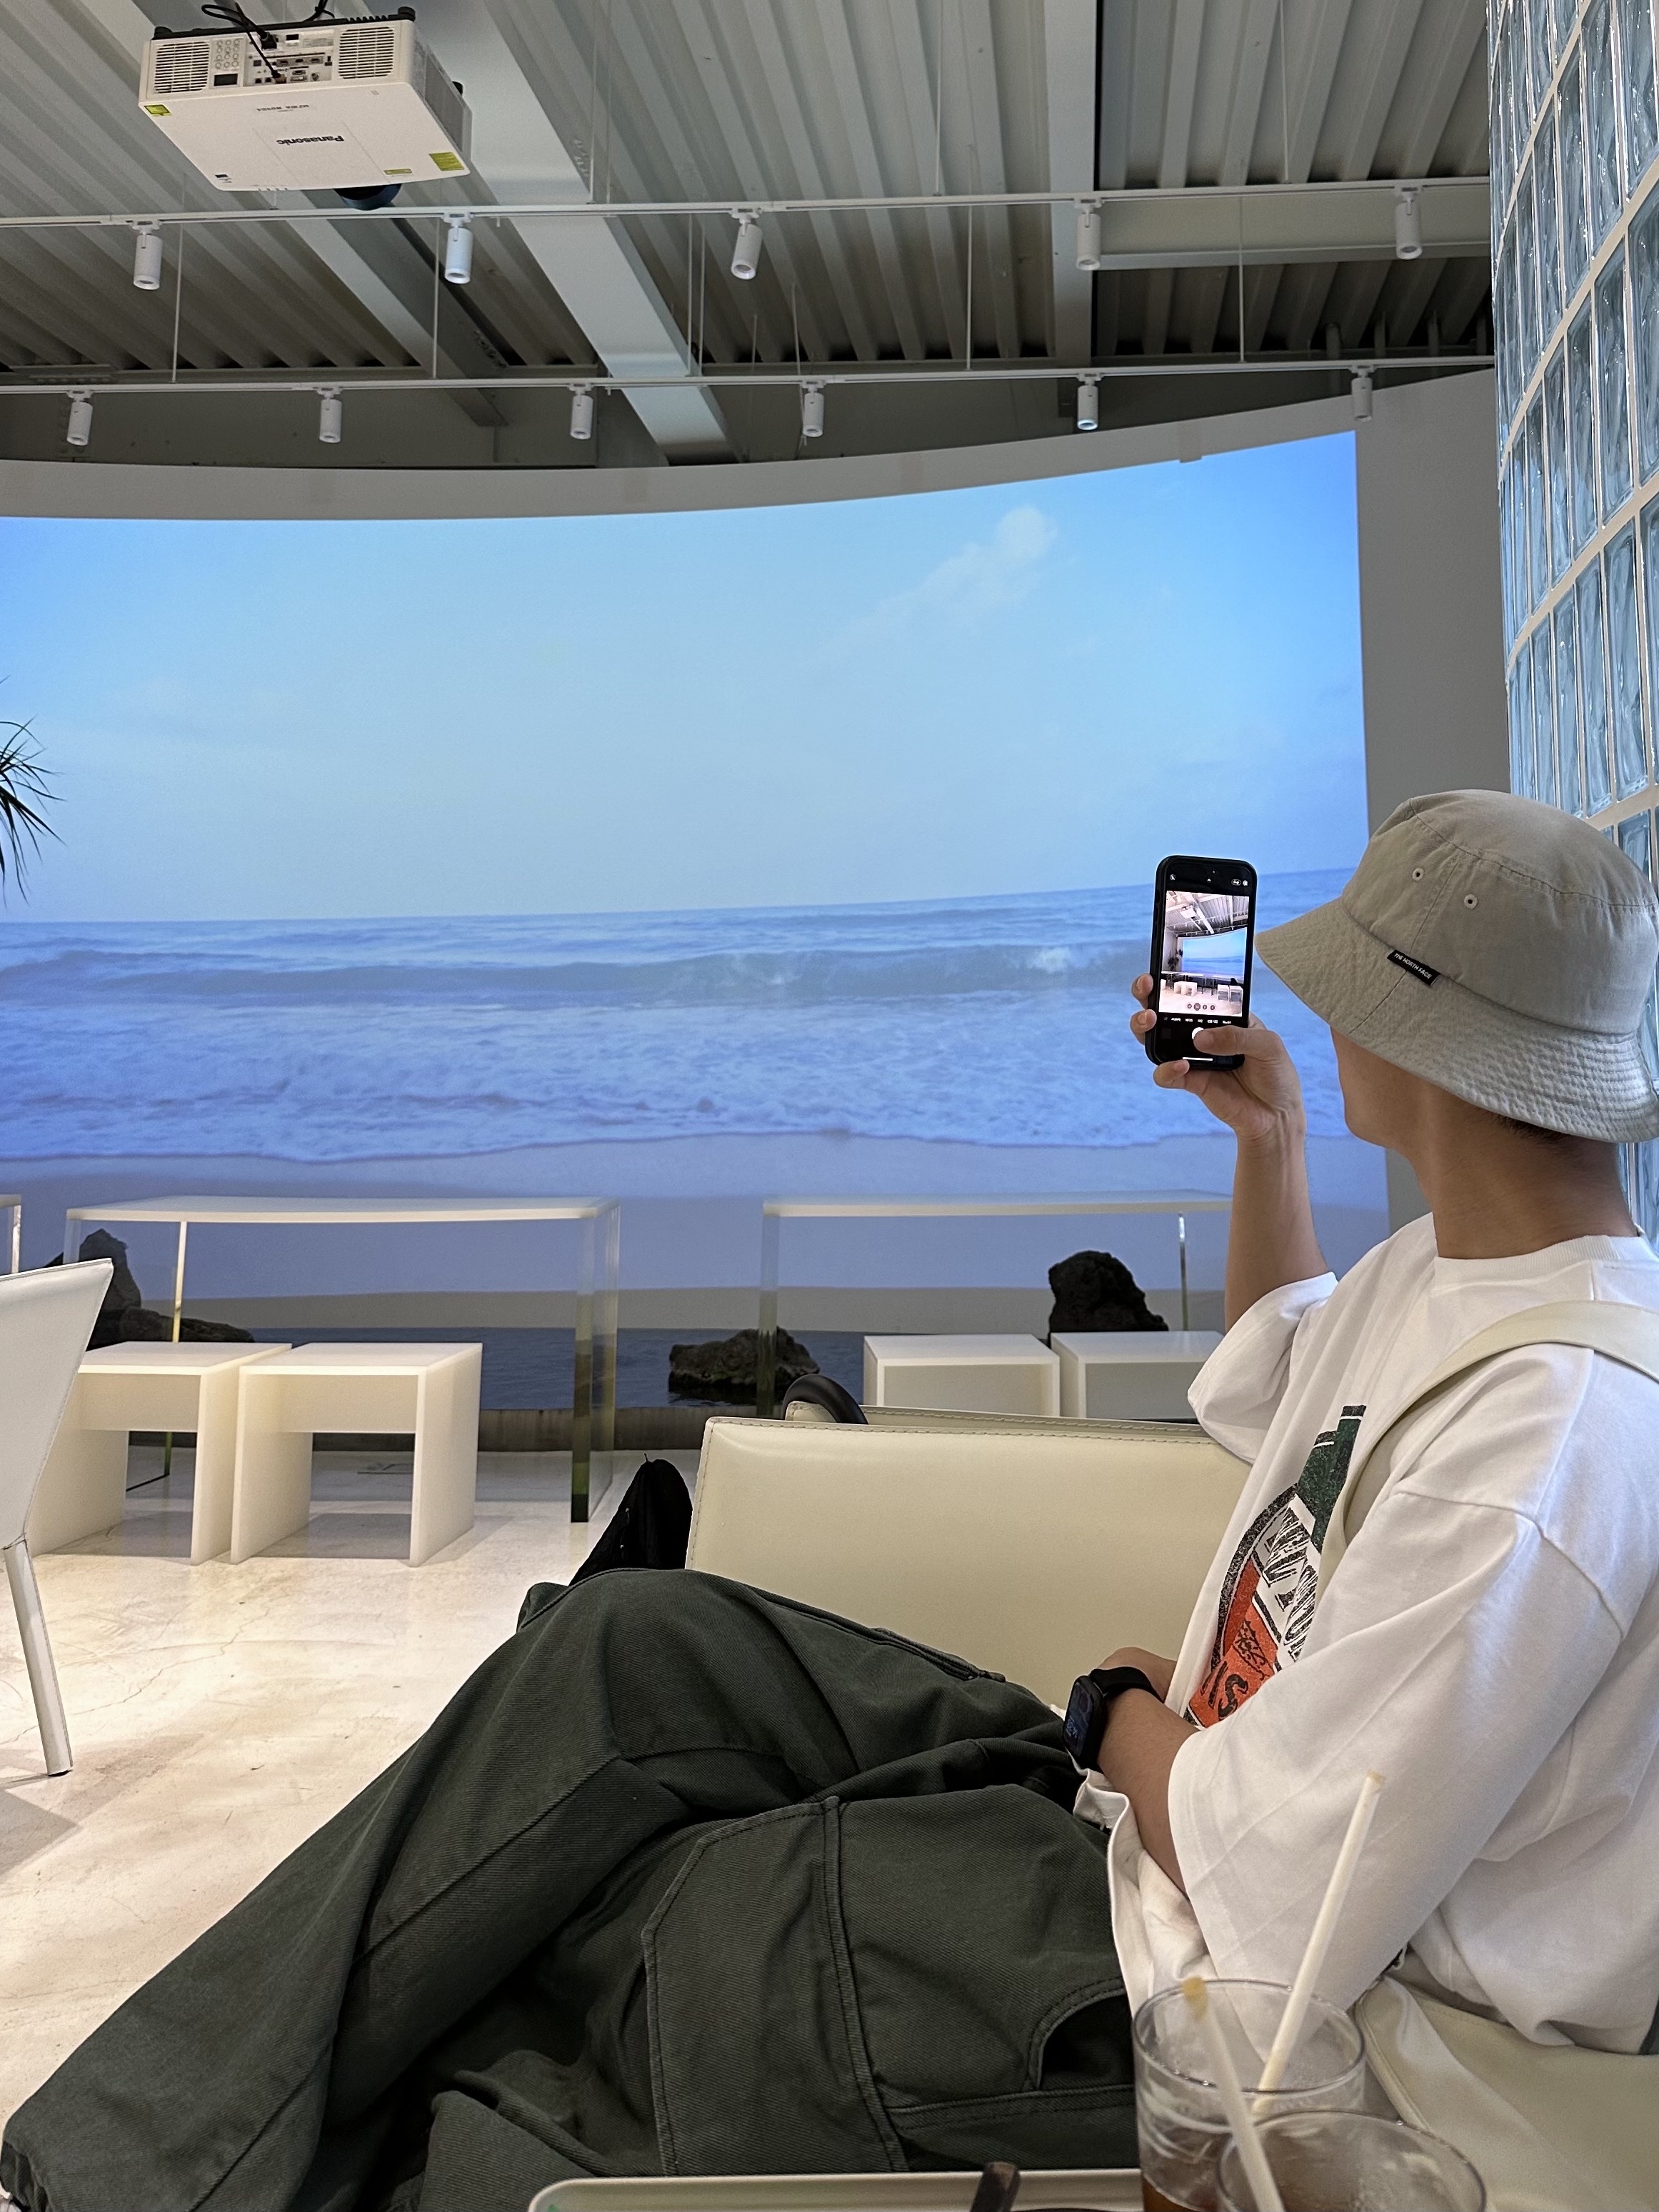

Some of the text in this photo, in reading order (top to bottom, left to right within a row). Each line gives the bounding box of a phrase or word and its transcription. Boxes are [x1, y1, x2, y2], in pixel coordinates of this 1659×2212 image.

[276, 135, 344, 145] Panasonic
[1402, 958, 1420, 970] NORTH
[1418, 967, 1433, 979] FACE
